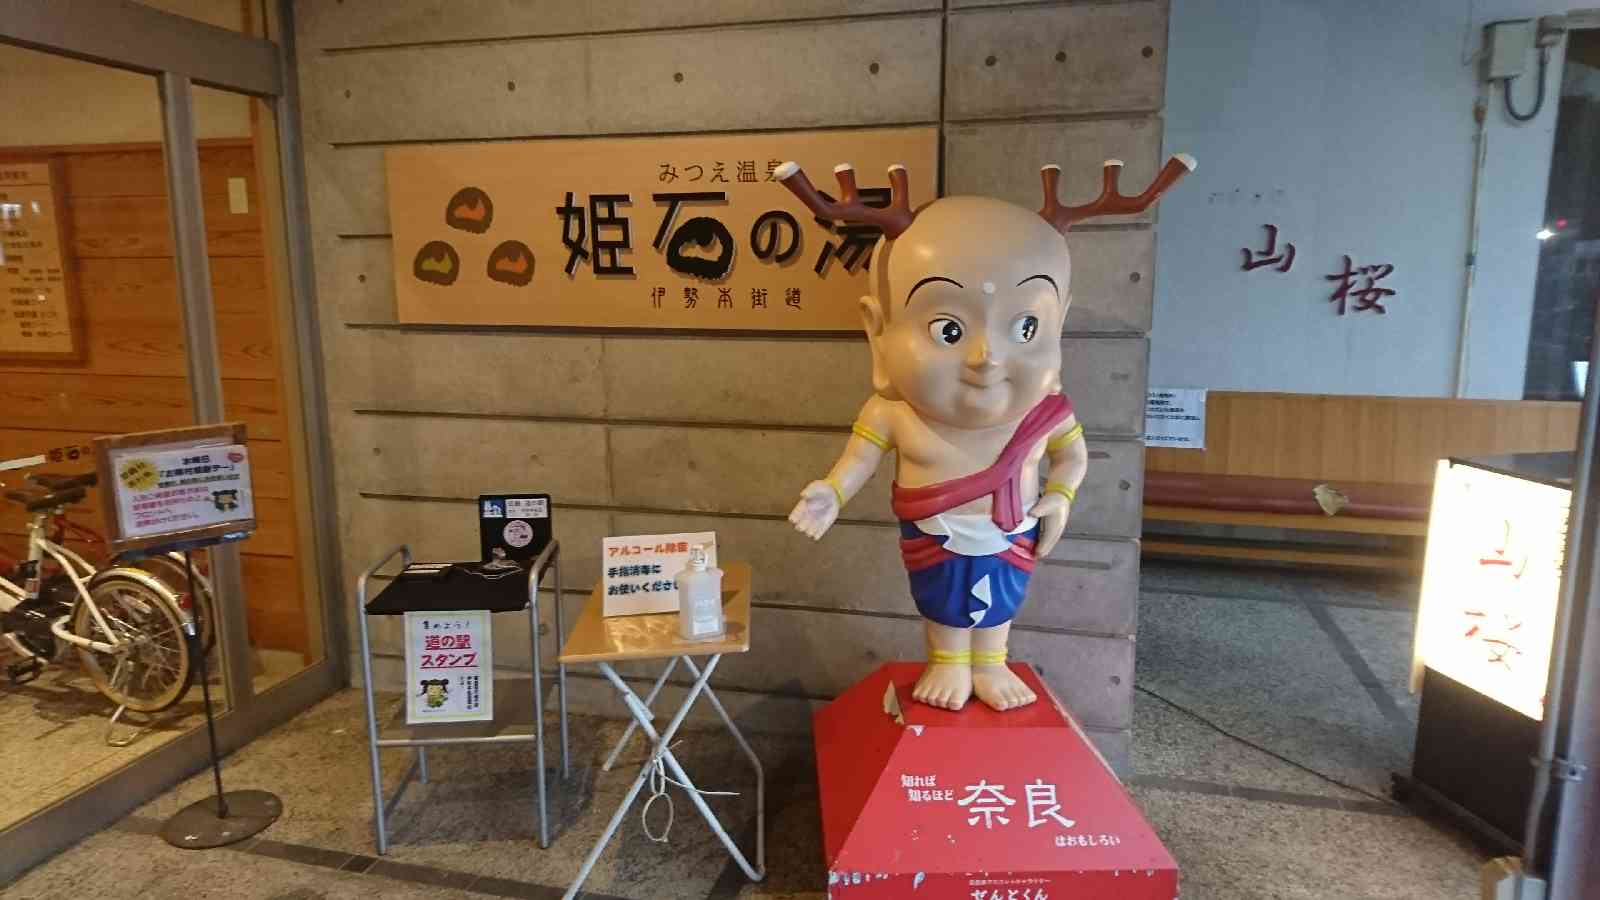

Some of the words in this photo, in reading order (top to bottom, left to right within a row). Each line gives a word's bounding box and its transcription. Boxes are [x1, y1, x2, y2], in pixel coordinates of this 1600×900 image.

[1240, 223, 1396, 316] 山桜
[650, 287, 802, 310] 伊勢本街道
[424, 634, 472, 650] 道の駅
[421, 651, 478, 667] スタンプ
[901, 774, 936, 788] 知れば
[908, 789, 954, 802] 知るほど
[957, 778, 1076, 830] 奈良
[1055, 834, 1121, 847] はおもしろい
